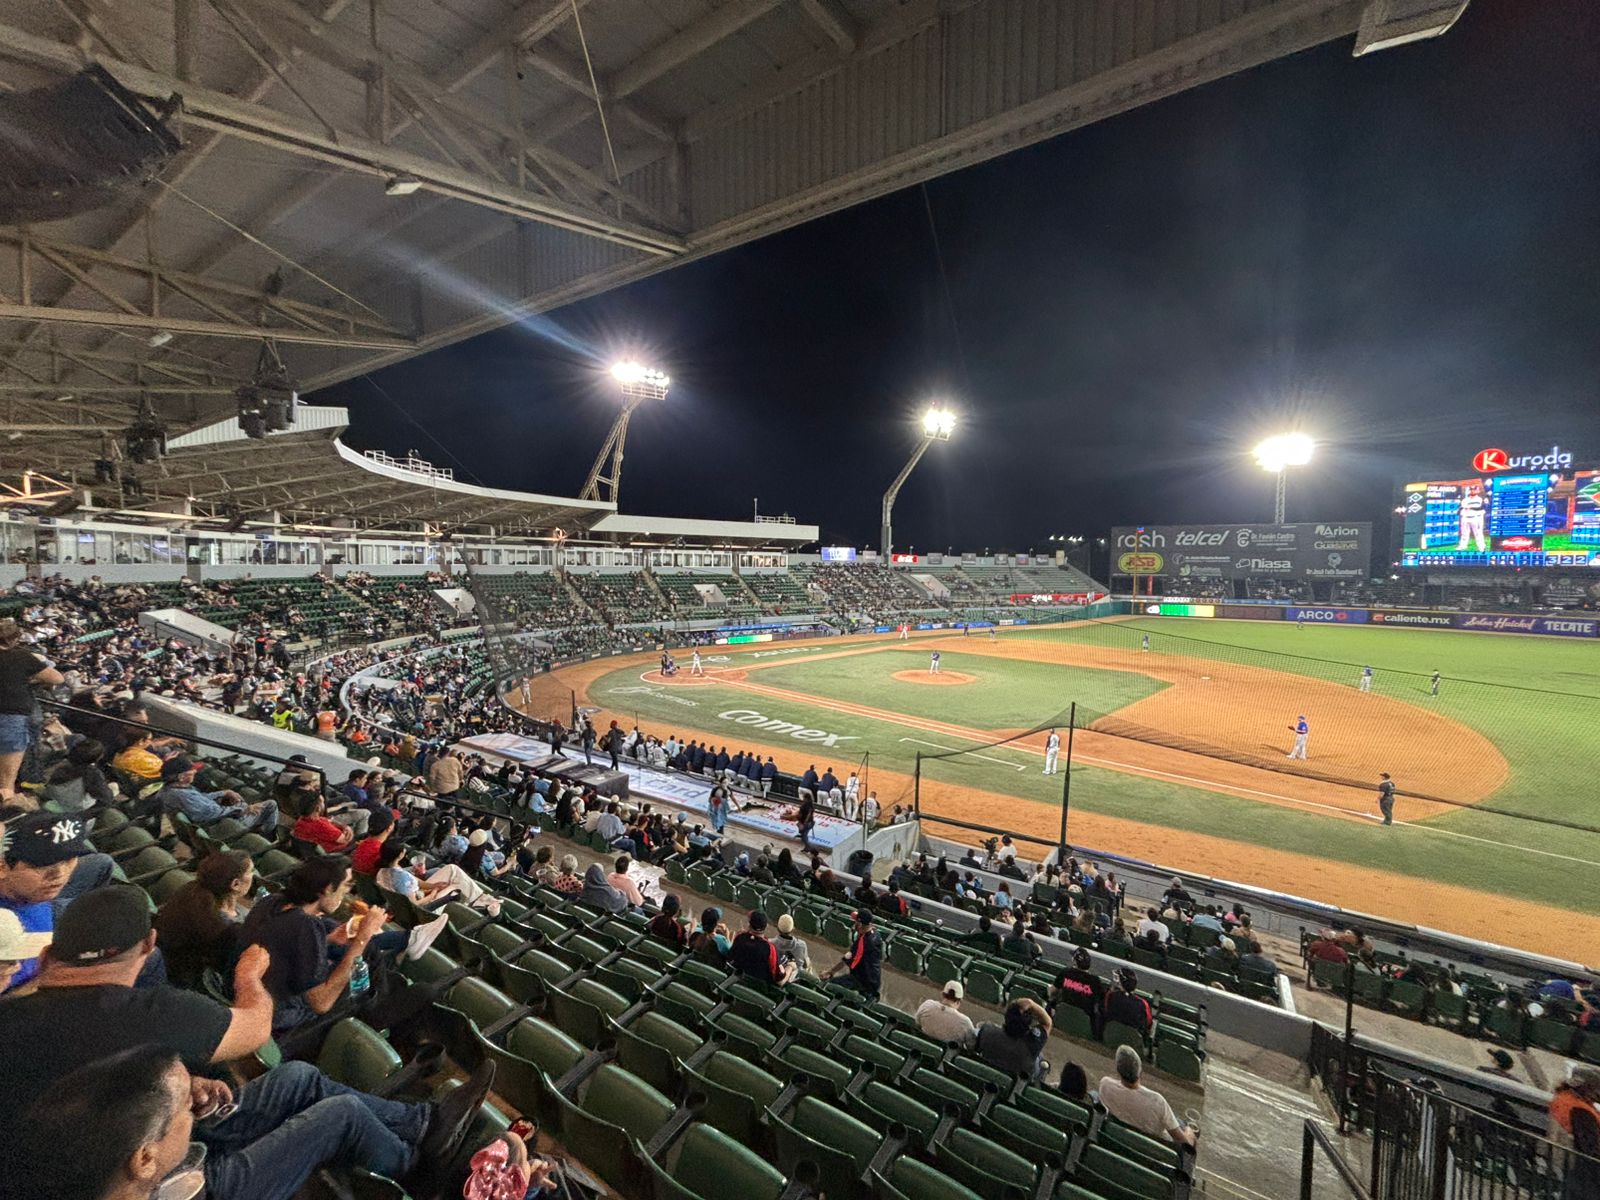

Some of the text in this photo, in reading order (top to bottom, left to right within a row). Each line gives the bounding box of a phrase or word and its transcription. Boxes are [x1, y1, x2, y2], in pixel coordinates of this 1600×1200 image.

[1482, 445, 1572, 470] Kuroda
[1530, 463, 1571, 471] PARK
[1323, 526, 1359, 536] Arion
[1175, 530, 1230, 546] telcel
[1562, 556, 1572, 564] 2
[1576, 556, 1586, 564] 2
[1297, 610, 1334, 621] ARCO
[1385, 614, 1450, 625] caliente.mx
[1544, 620, 1593, 633] TECATE
